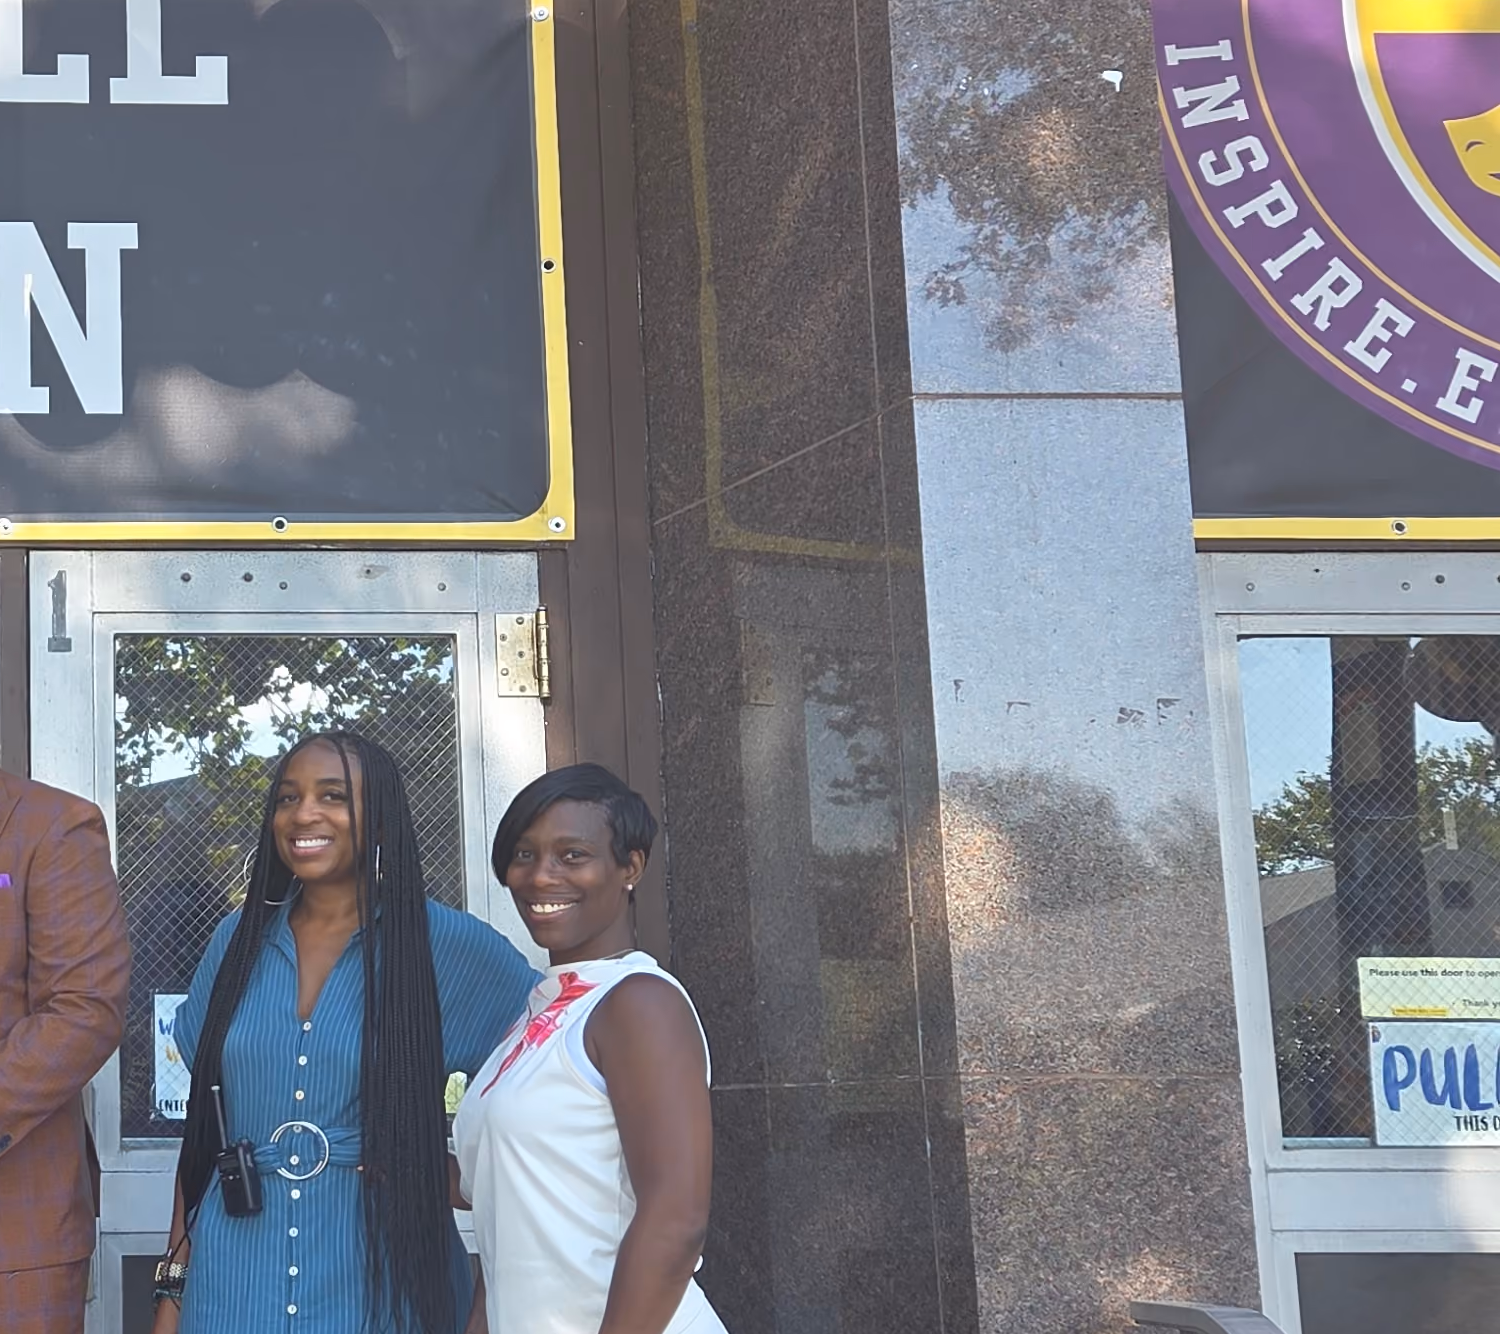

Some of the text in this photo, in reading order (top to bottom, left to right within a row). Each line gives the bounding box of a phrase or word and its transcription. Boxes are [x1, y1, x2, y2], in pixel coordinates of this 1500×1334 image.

[48, 570, 72, 652] 1
[1369, 968, 1399, 977] Please
[1420, 968, 1438, 977] this
[1441, 968, 1463, 977] door
[1383, 1044, 1500, 1111] PUL
[1452, 1114, 1489, 1131] THIS
